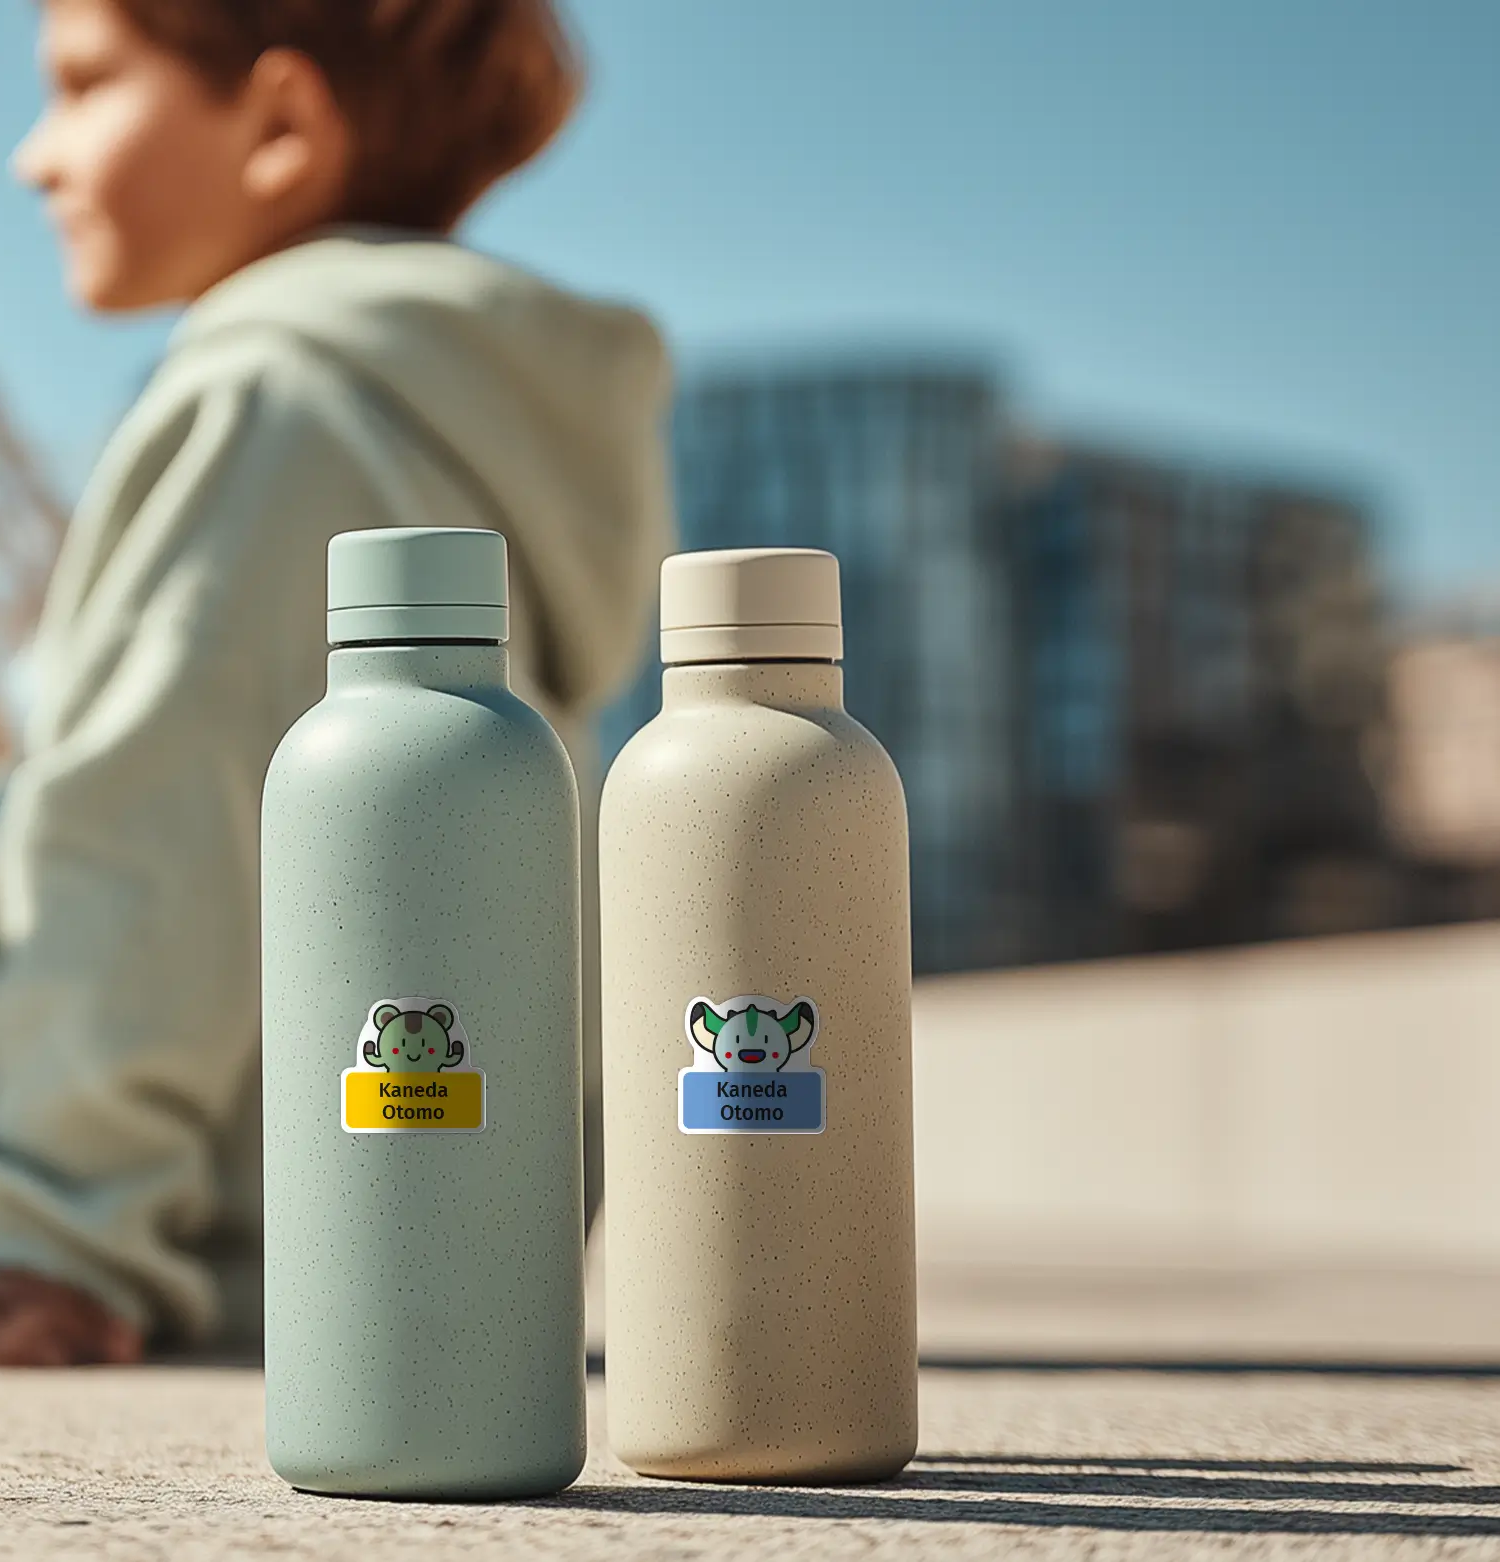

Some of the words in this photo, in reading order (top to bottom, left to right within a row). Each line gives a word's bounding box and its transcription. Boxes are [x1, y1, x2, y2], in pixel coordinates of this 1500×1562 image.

[379, 1082, 448, 1098] Kaneda
[717, 1080, 787, 1098] Kaneda
[382, 1104, 445, 1120] Otomo
[720, 1104, 784, 1120] Otomo
